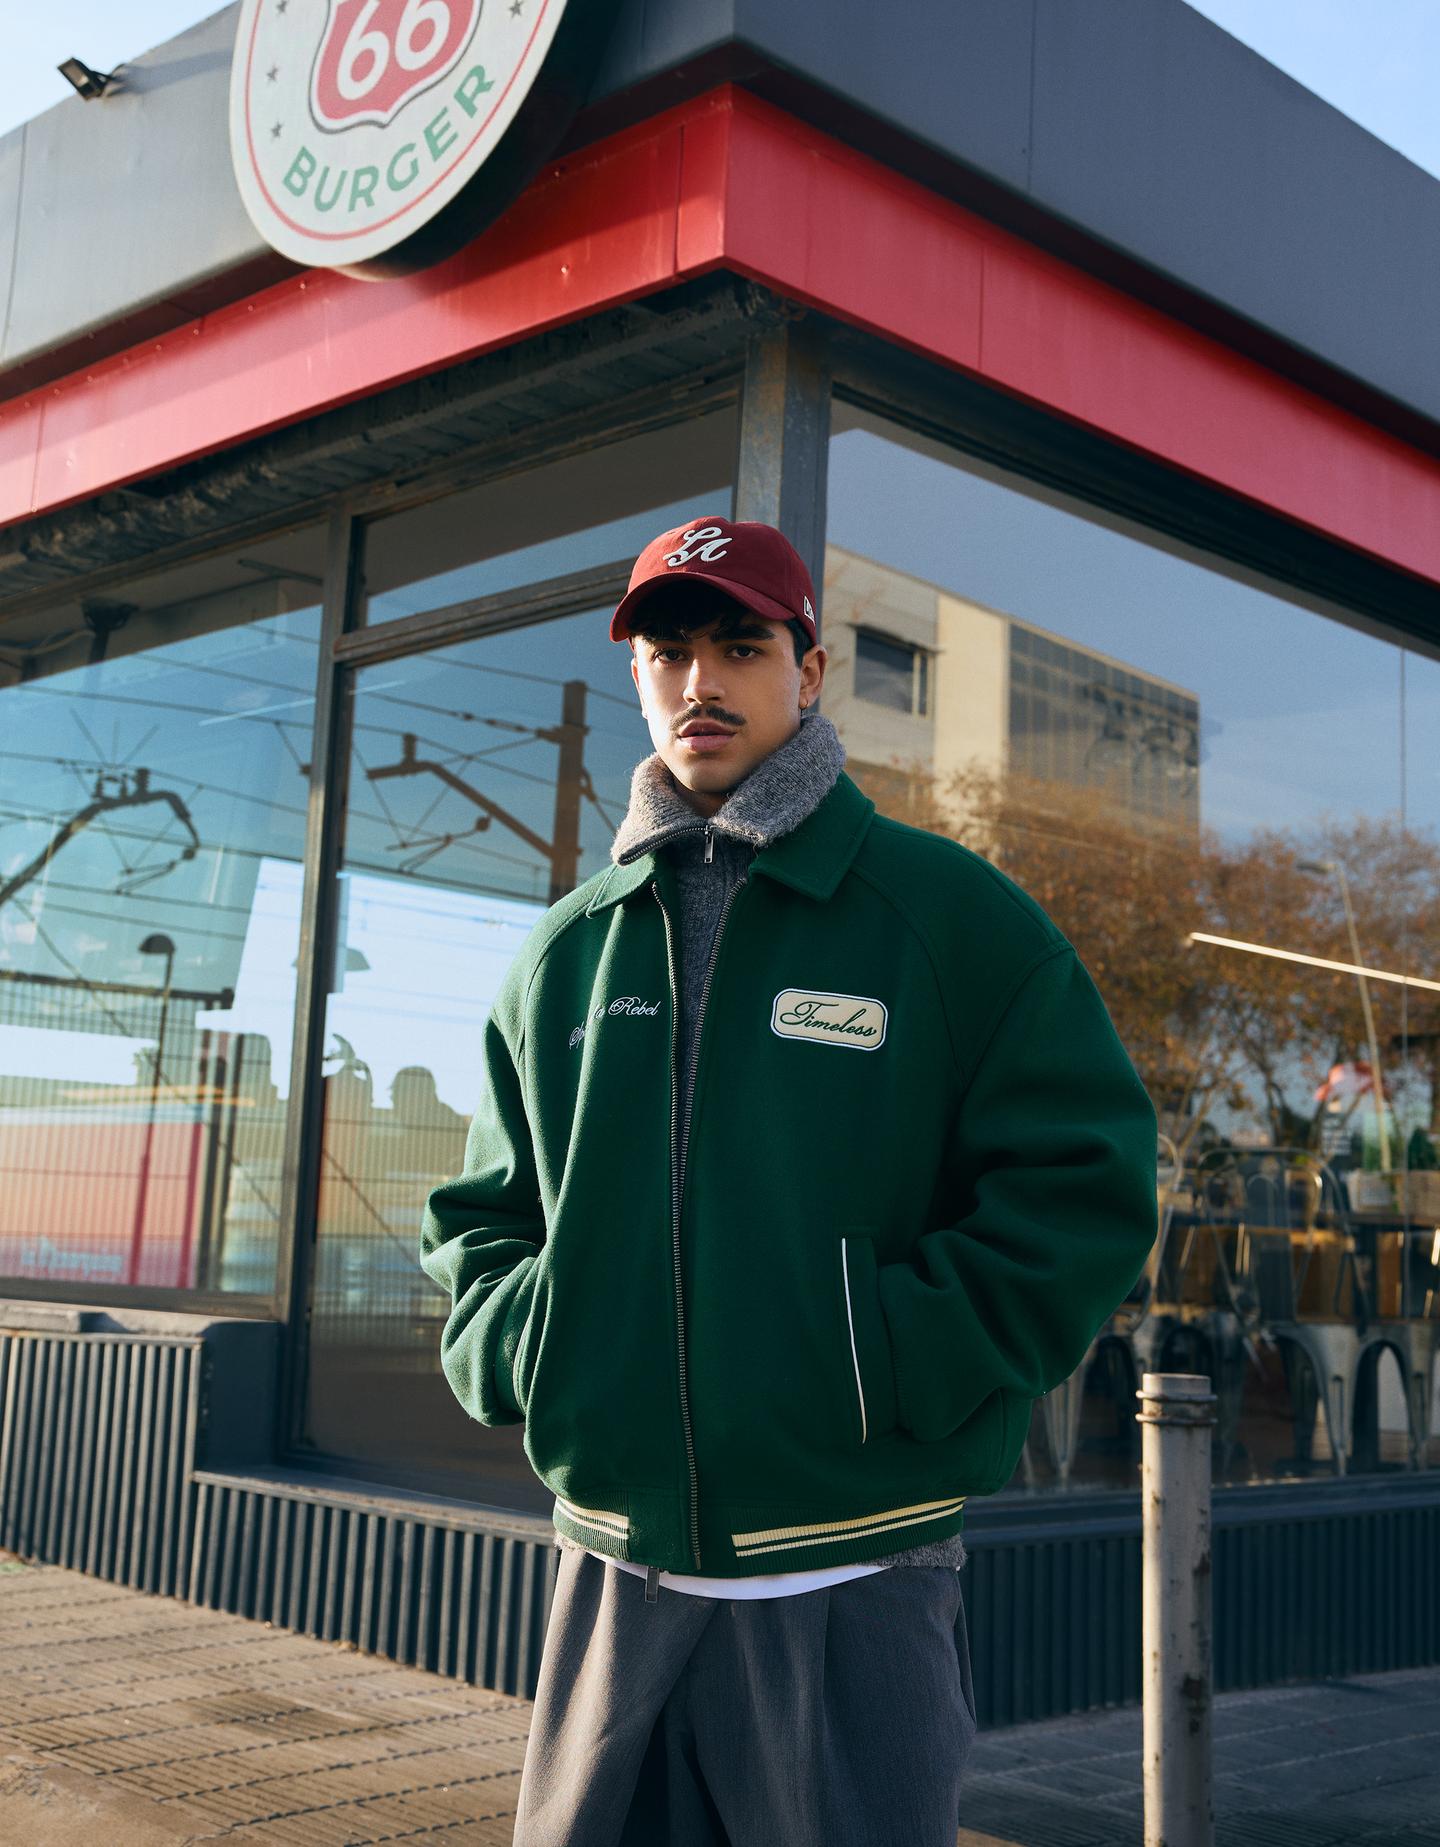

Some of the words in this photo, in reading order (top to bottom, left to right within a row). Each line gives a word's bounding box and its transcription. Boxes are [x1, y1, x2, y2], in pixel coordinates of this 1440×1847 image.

[337, 0, 450, 100] 66
[282, 65, 495, 212] BURGER
[608, 997, 661, 1016] Rebel
[780, 1001, 877, 1036] Timeless
